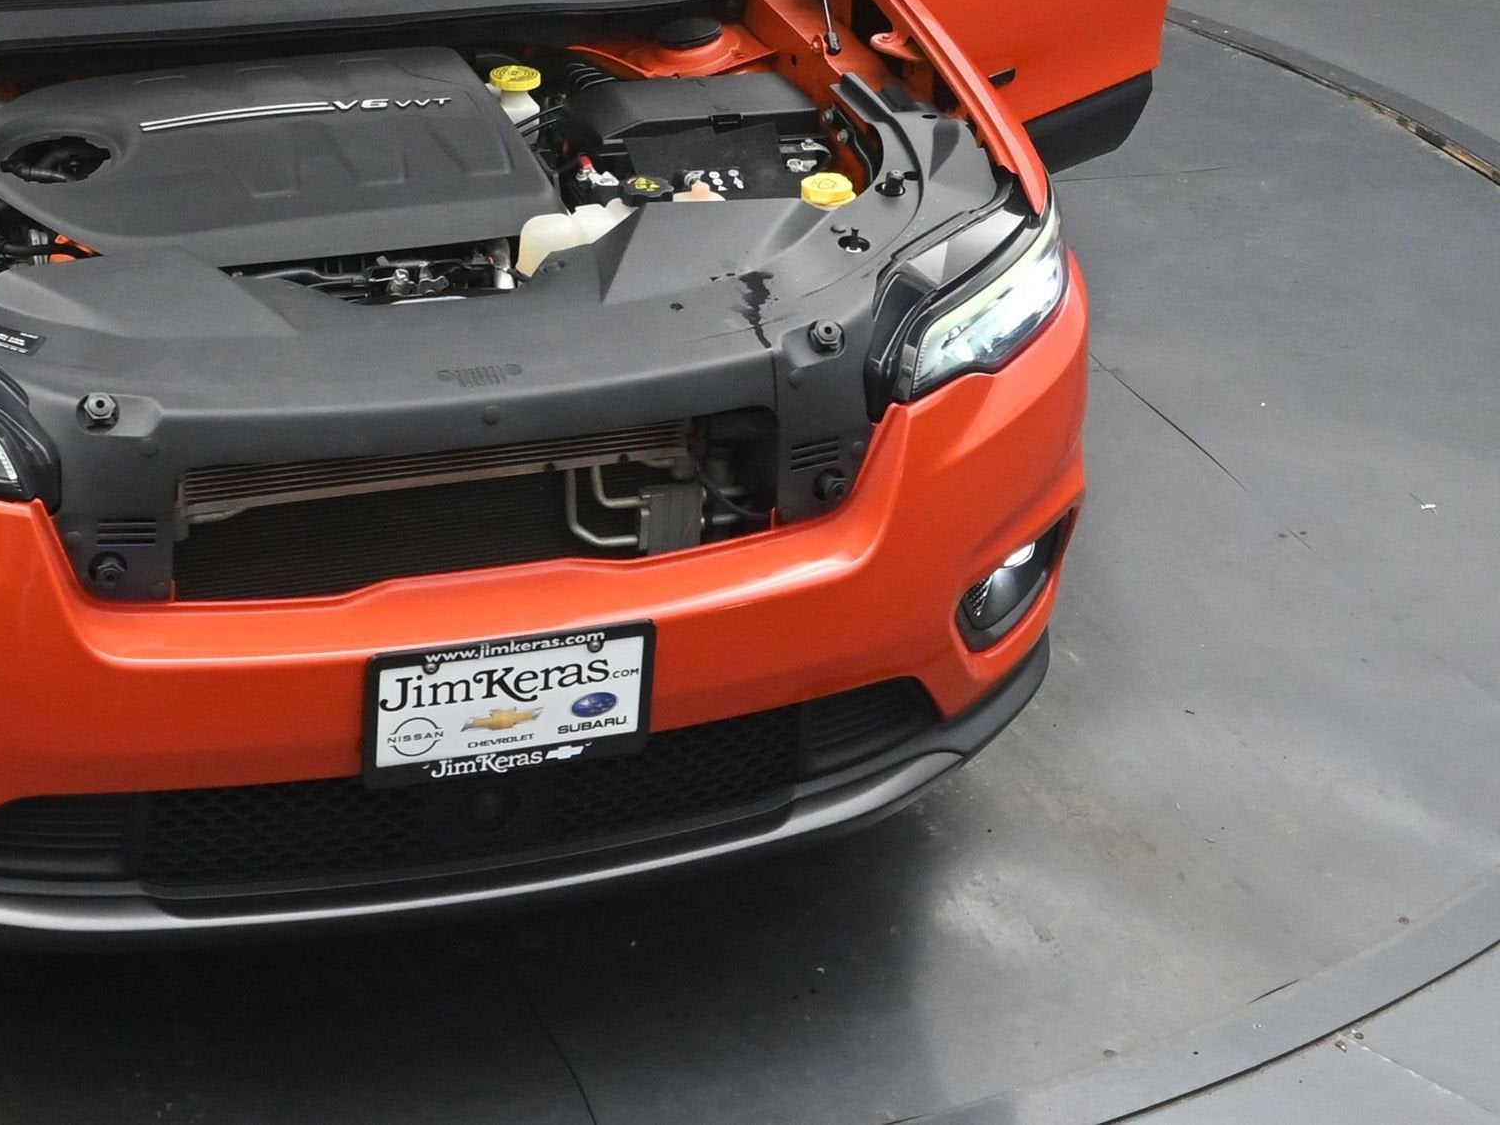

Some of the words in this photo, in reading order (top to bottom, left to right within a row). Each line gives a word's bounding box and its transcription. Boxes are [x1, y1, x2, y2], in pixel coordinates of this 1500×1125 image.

[332, 98, 389, 110] V6
[394, 97, 452, 108] VVT
[425, 631, 605, 663] www.jimkeras.com
[557, 715, 628, 735] SUBARU
[387, 730, 444, 744] NISSAN
[467, 733, 535, 749] CHEVROLET
